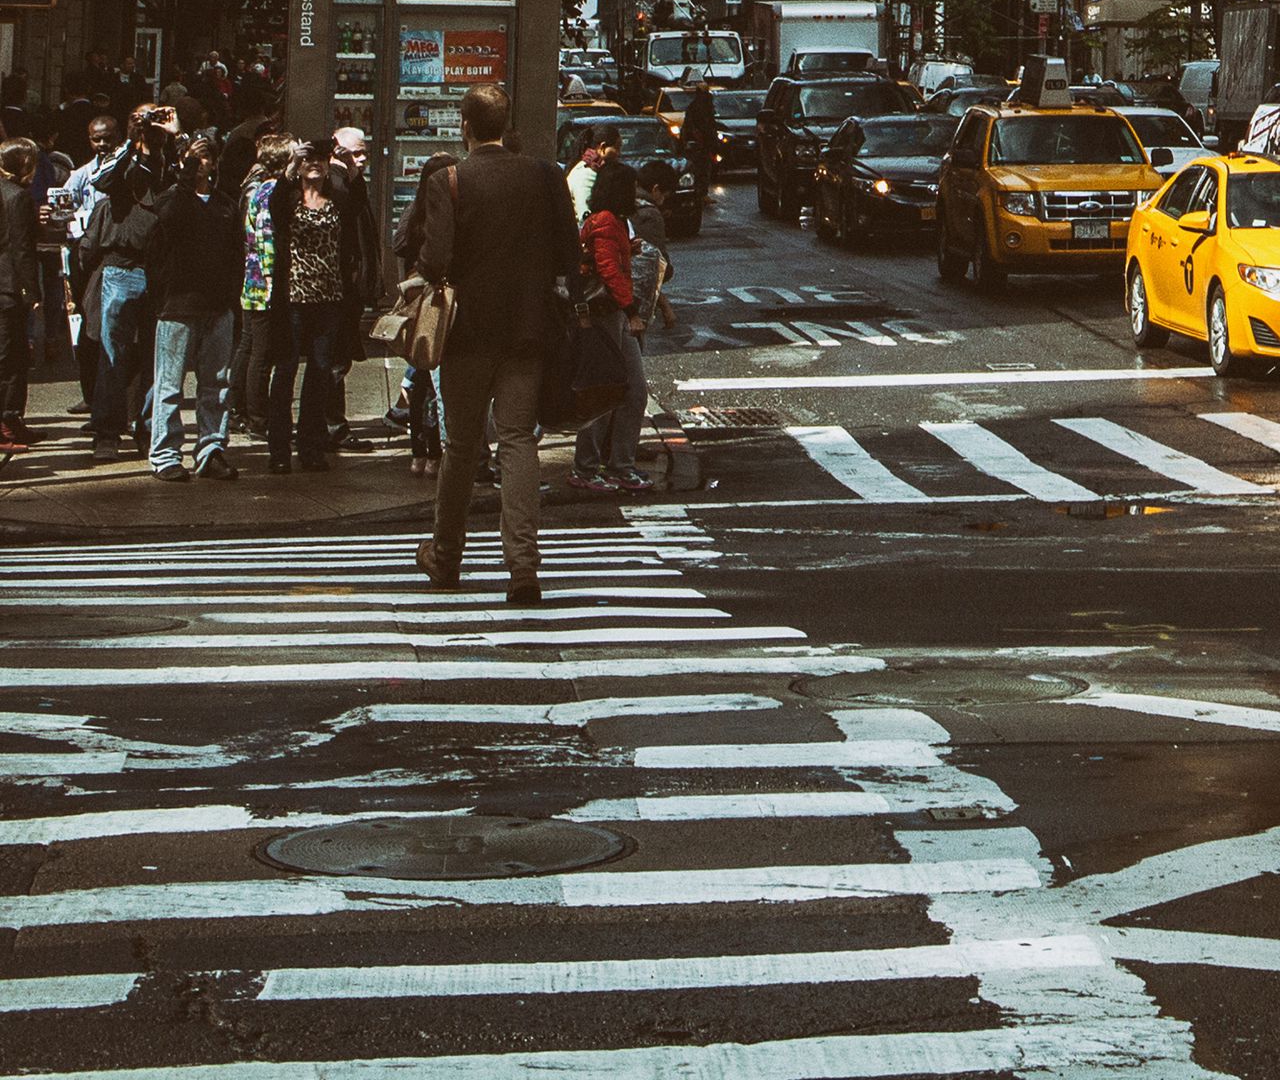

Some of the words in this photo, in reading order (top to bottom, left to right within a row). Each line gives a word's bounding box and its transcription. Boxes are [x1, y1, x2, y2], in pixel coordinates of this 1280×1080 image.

[406, 39, 439, 53] MEGA
[445, 67, 464, 75] PLAY
[466, 66, 492, 75] BOTH!
[684, 321, 966, 345] ONLY
